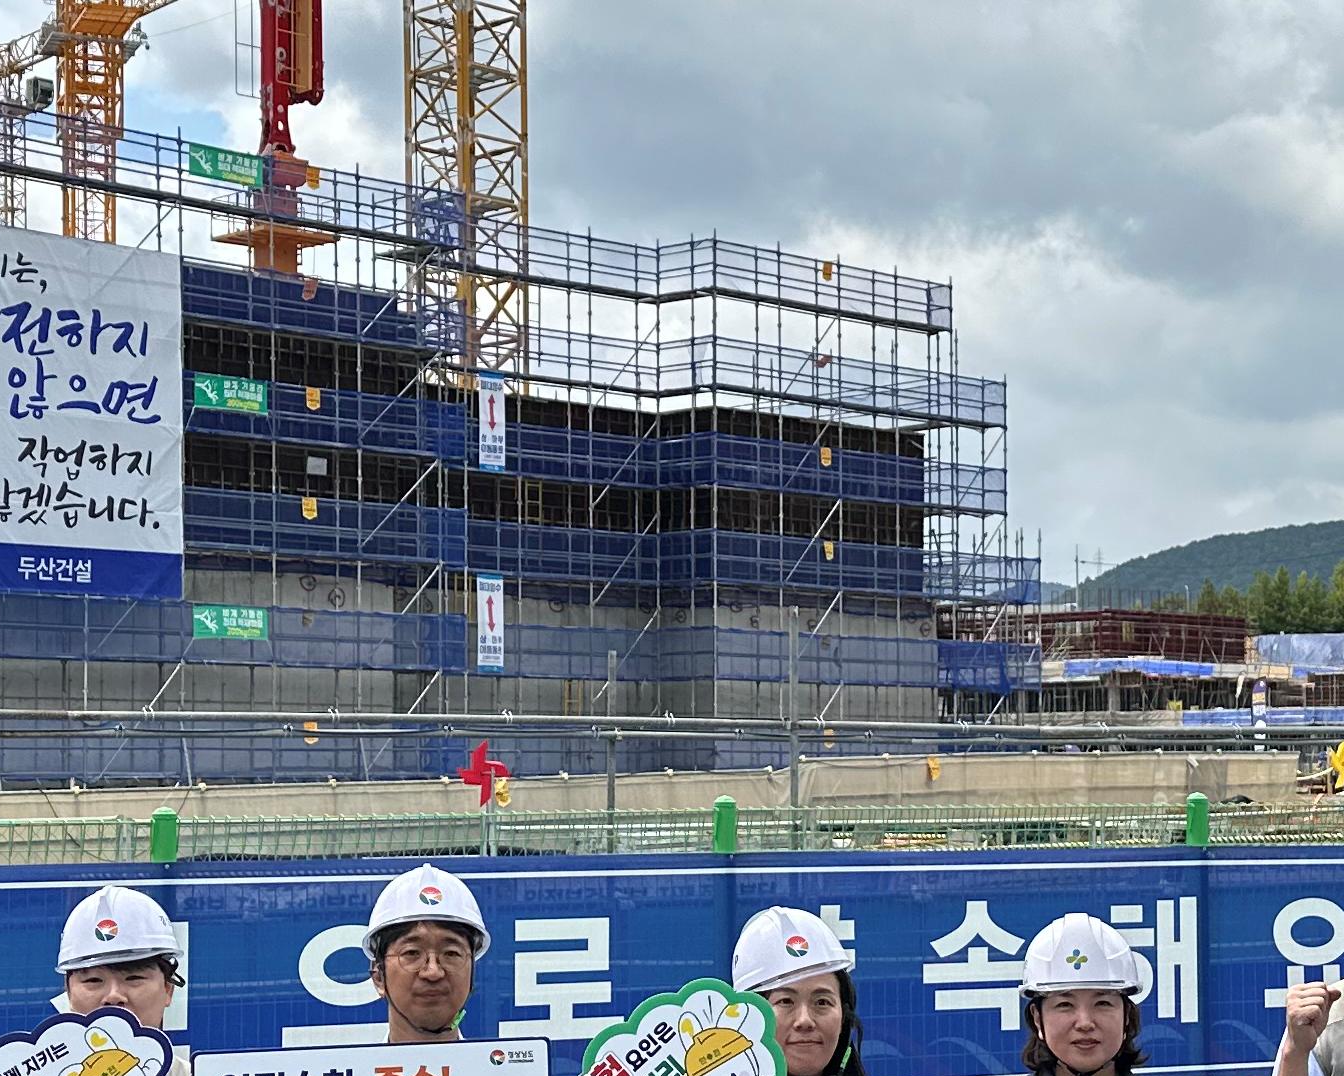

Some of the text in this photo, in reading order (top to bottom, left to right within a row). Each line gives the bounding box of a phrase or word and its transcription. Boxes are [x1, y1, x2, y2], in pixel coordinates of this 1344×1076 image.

[7, 357, 162, 424] 않으면
[17, 434, 153, 480] 작업하지
[17, 555, 93, 584] 두산건설
[21, 1042, 70, 1076] 지키는
[625, 1021, 677, 1073] 요인은
